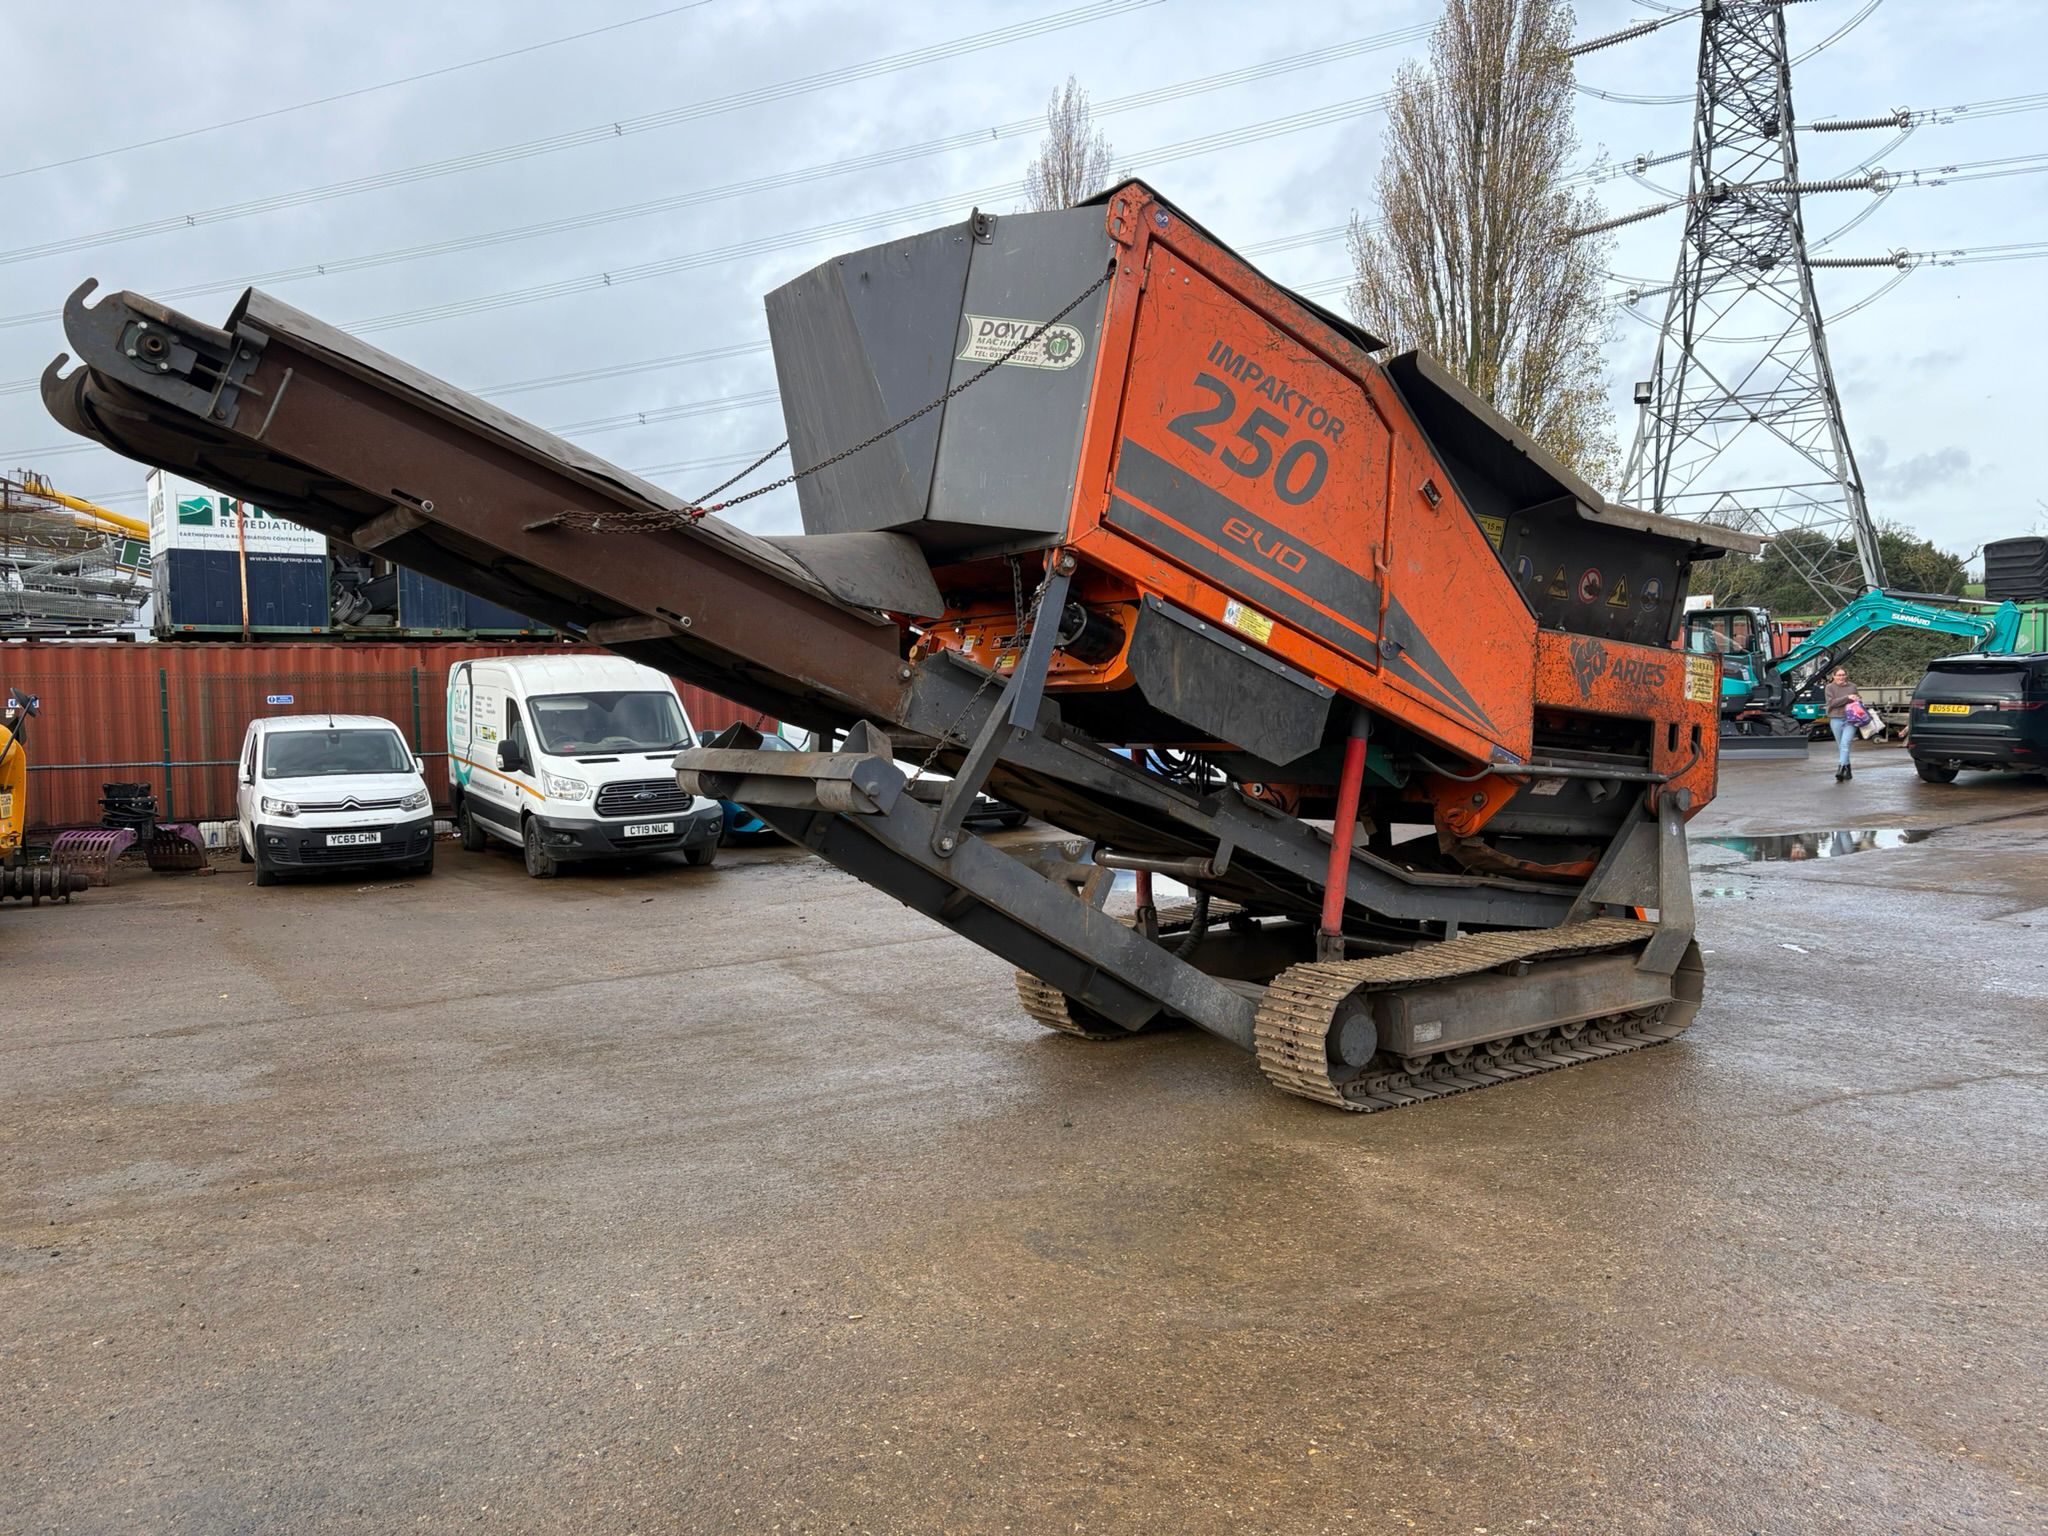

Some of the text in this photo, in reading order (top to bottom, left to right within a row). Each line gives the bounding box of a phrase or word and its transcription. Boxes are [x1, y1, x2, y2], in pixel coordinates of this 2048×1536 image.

[977, 338, 1039, 349] MACHINRY
[1207, 339, 1345, 443] IMPAKTOR
[1165, 372, 1328, 505] 250
[1891, 613, 1930, 626] SUNWARD
[630, 824, 669, 835] CT19 NUC
[331, 833, 377, 844] YC69 CHN
